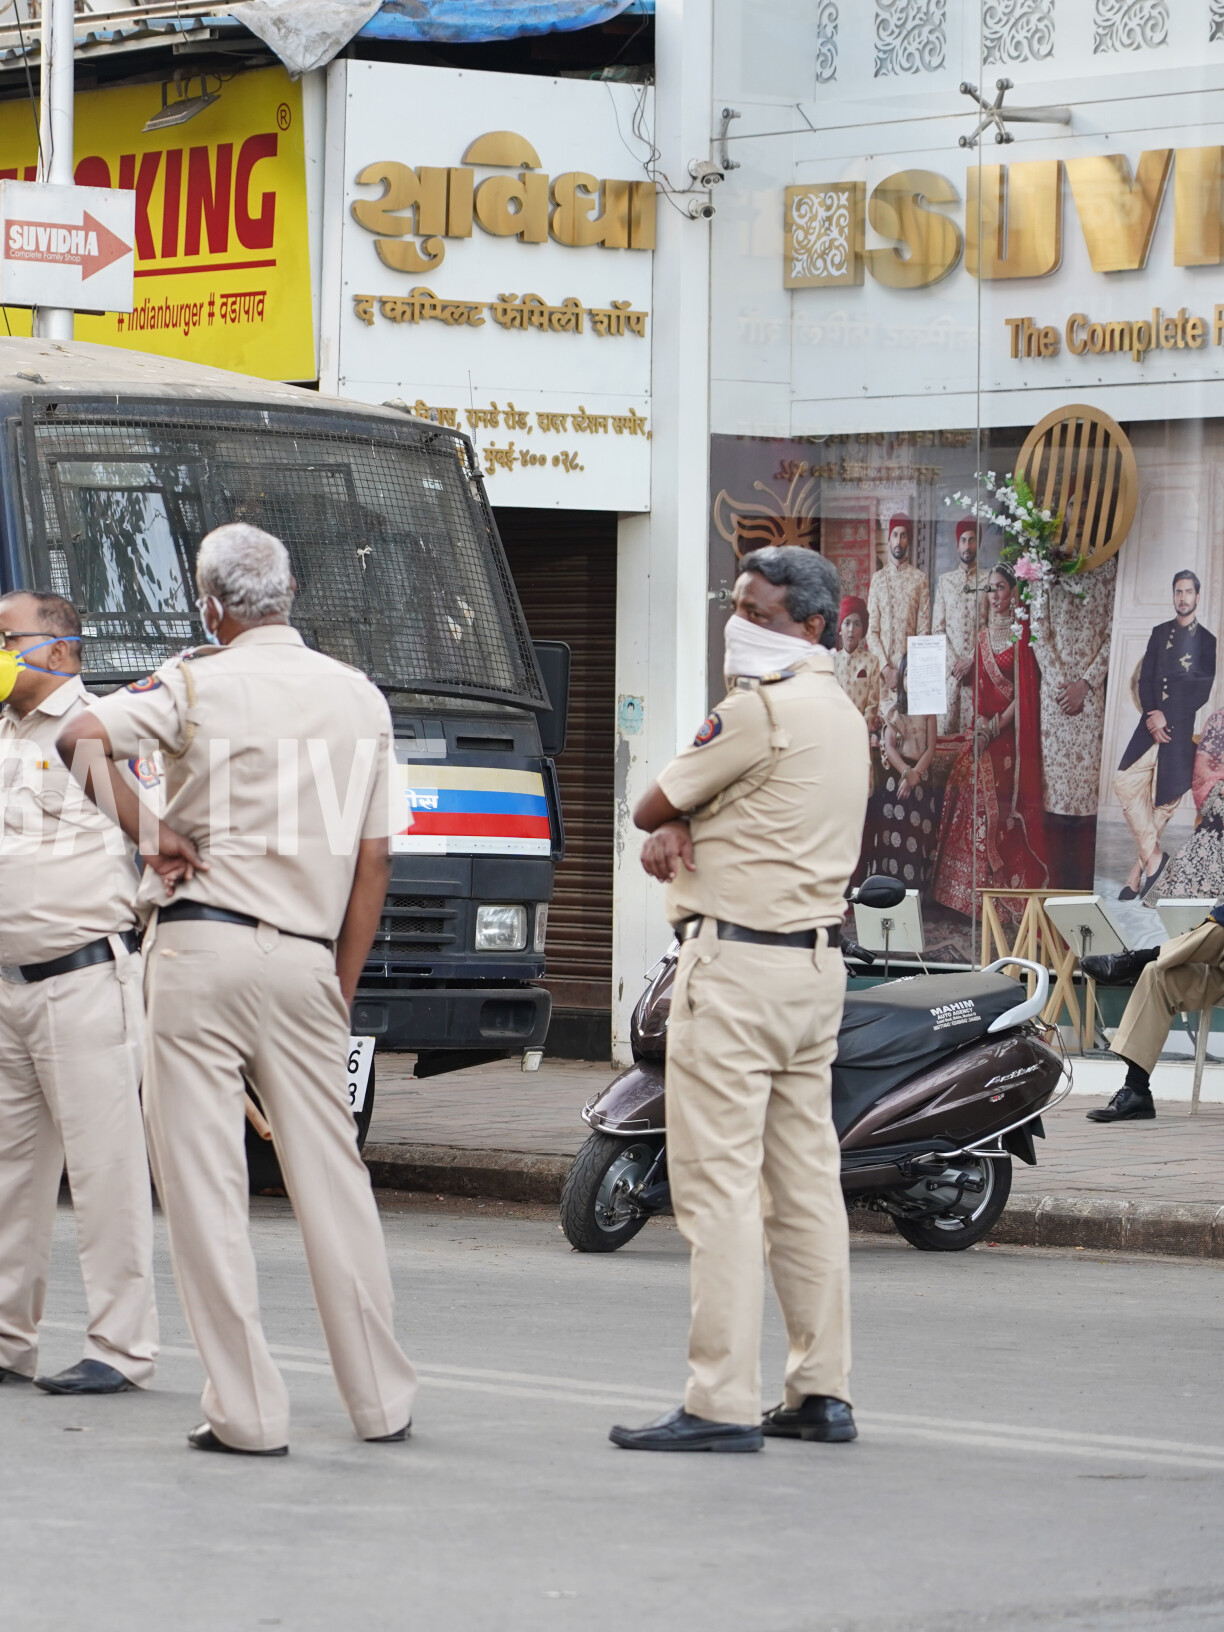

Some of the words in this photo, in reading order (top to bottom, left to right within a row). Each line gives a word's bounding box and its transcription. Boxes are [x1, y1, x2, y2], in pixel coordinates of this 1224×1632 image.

[8, 225, 99, 256] SUVIDHA
[10, 250, 43, 260] Complete
[43, 250, 64, 262] Family
[64, 252, 81, 263] Shop
[1005, 316, 1060, 359] The
[1065, 306, 1207, 363] Complete
[930, 999, 975, 1016] MAHIM
[937, 1012, 952, 1020] AUTO
[953, 1007, 973, 1016] AGENCY
